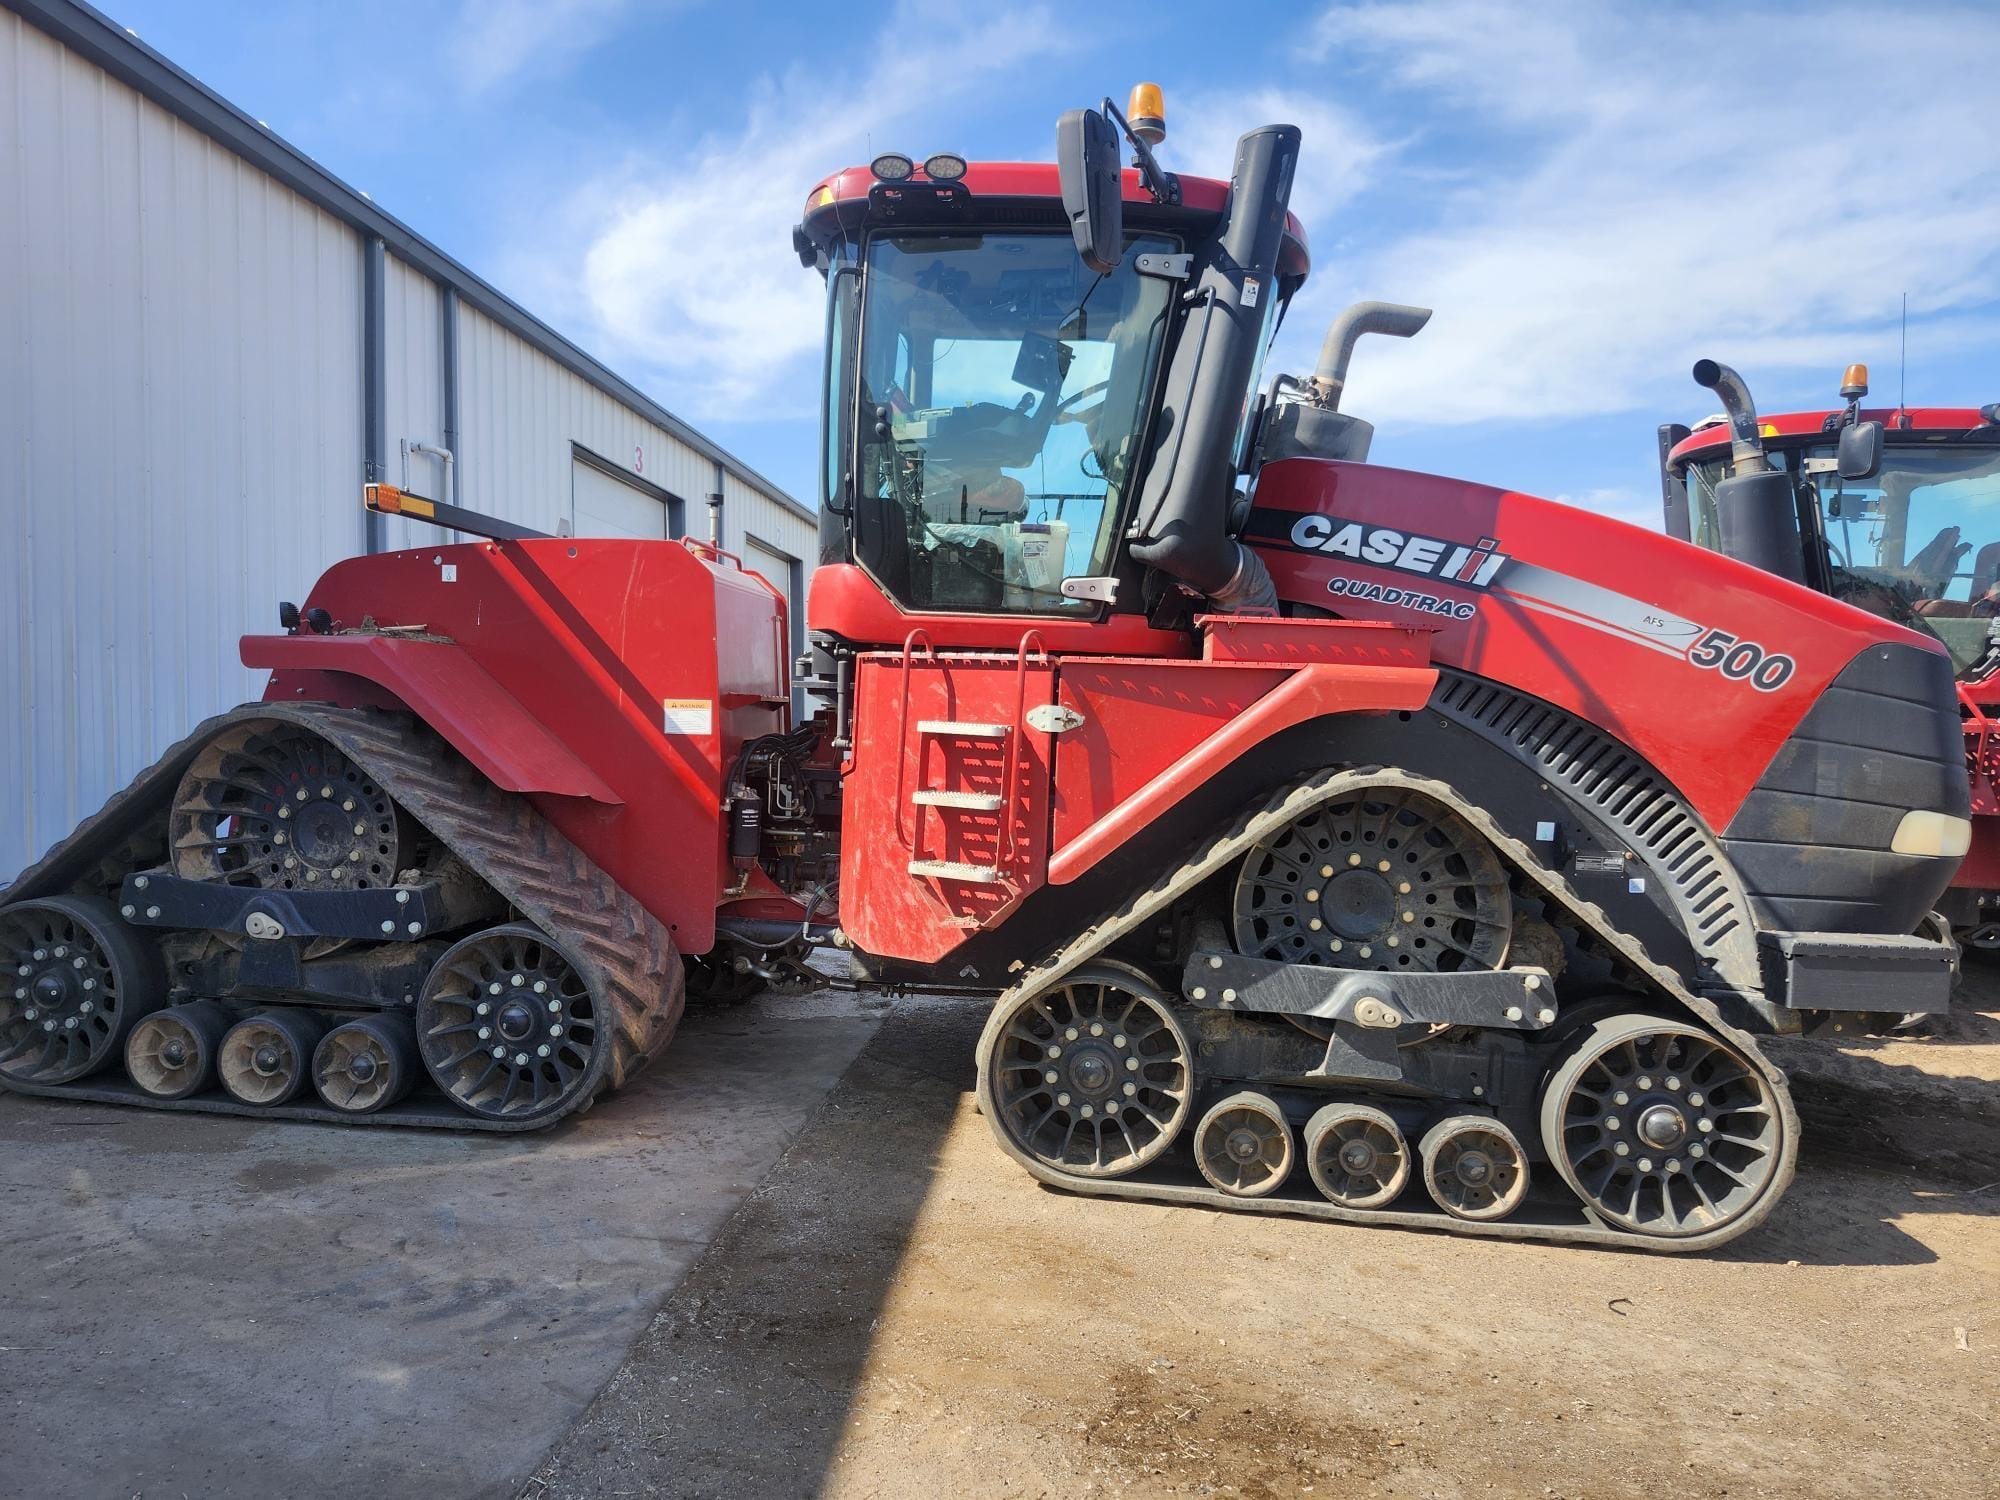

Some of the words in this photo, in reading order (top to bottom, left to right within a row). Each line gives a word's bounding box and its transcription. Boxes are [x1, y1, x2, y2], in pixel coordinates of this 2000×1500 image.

[635, 446, 643, 473] 3
[1291, 515, 1447, 573] CASE
[1327, 577, 1475, 620] QUADTRAC
[1642, 615, 1665, 628] AFS
[1688, 628, 1796, 693] 500
